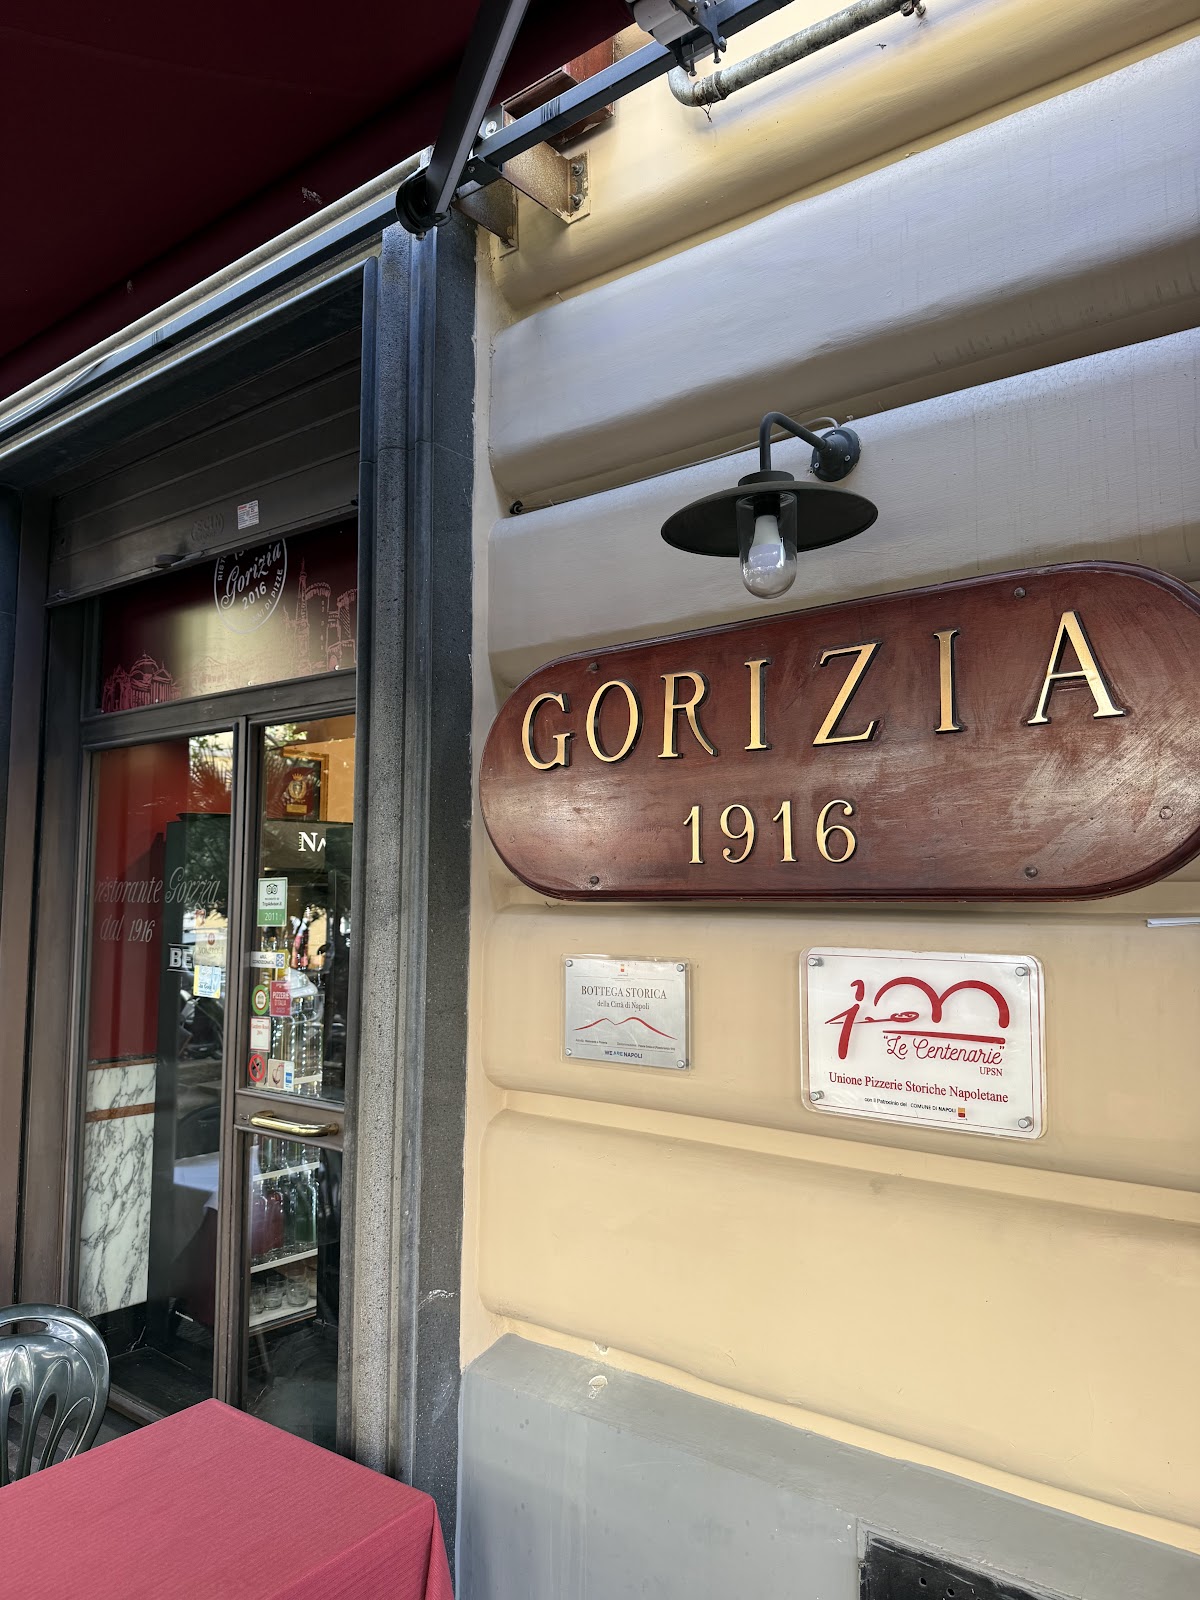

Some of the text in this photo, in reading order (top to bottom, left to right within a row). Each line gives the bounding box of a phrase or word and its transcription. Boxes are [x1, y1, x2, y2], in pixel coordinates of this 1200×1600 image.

[242, 581, 267, 610] 2016
[270, 568, 284, 599] PIZZE
[521, 610, 1127, 771] GORIZIA
[683, 799, 857, 865] 1916
[100, 913, 156, 942] dal 1916
[581, 985, 667, 999] BOTTEGA STORICA
[597, 1000, 610, 1008] della
[610, 1000, 624, 1009] Città
[631, 1003, 650, 1011] Napoli
[979, 1066, 1003, 1077] UPSN
[829, 1072, 1009, 1103] Unione Pizzerie Storiche Napoletane
